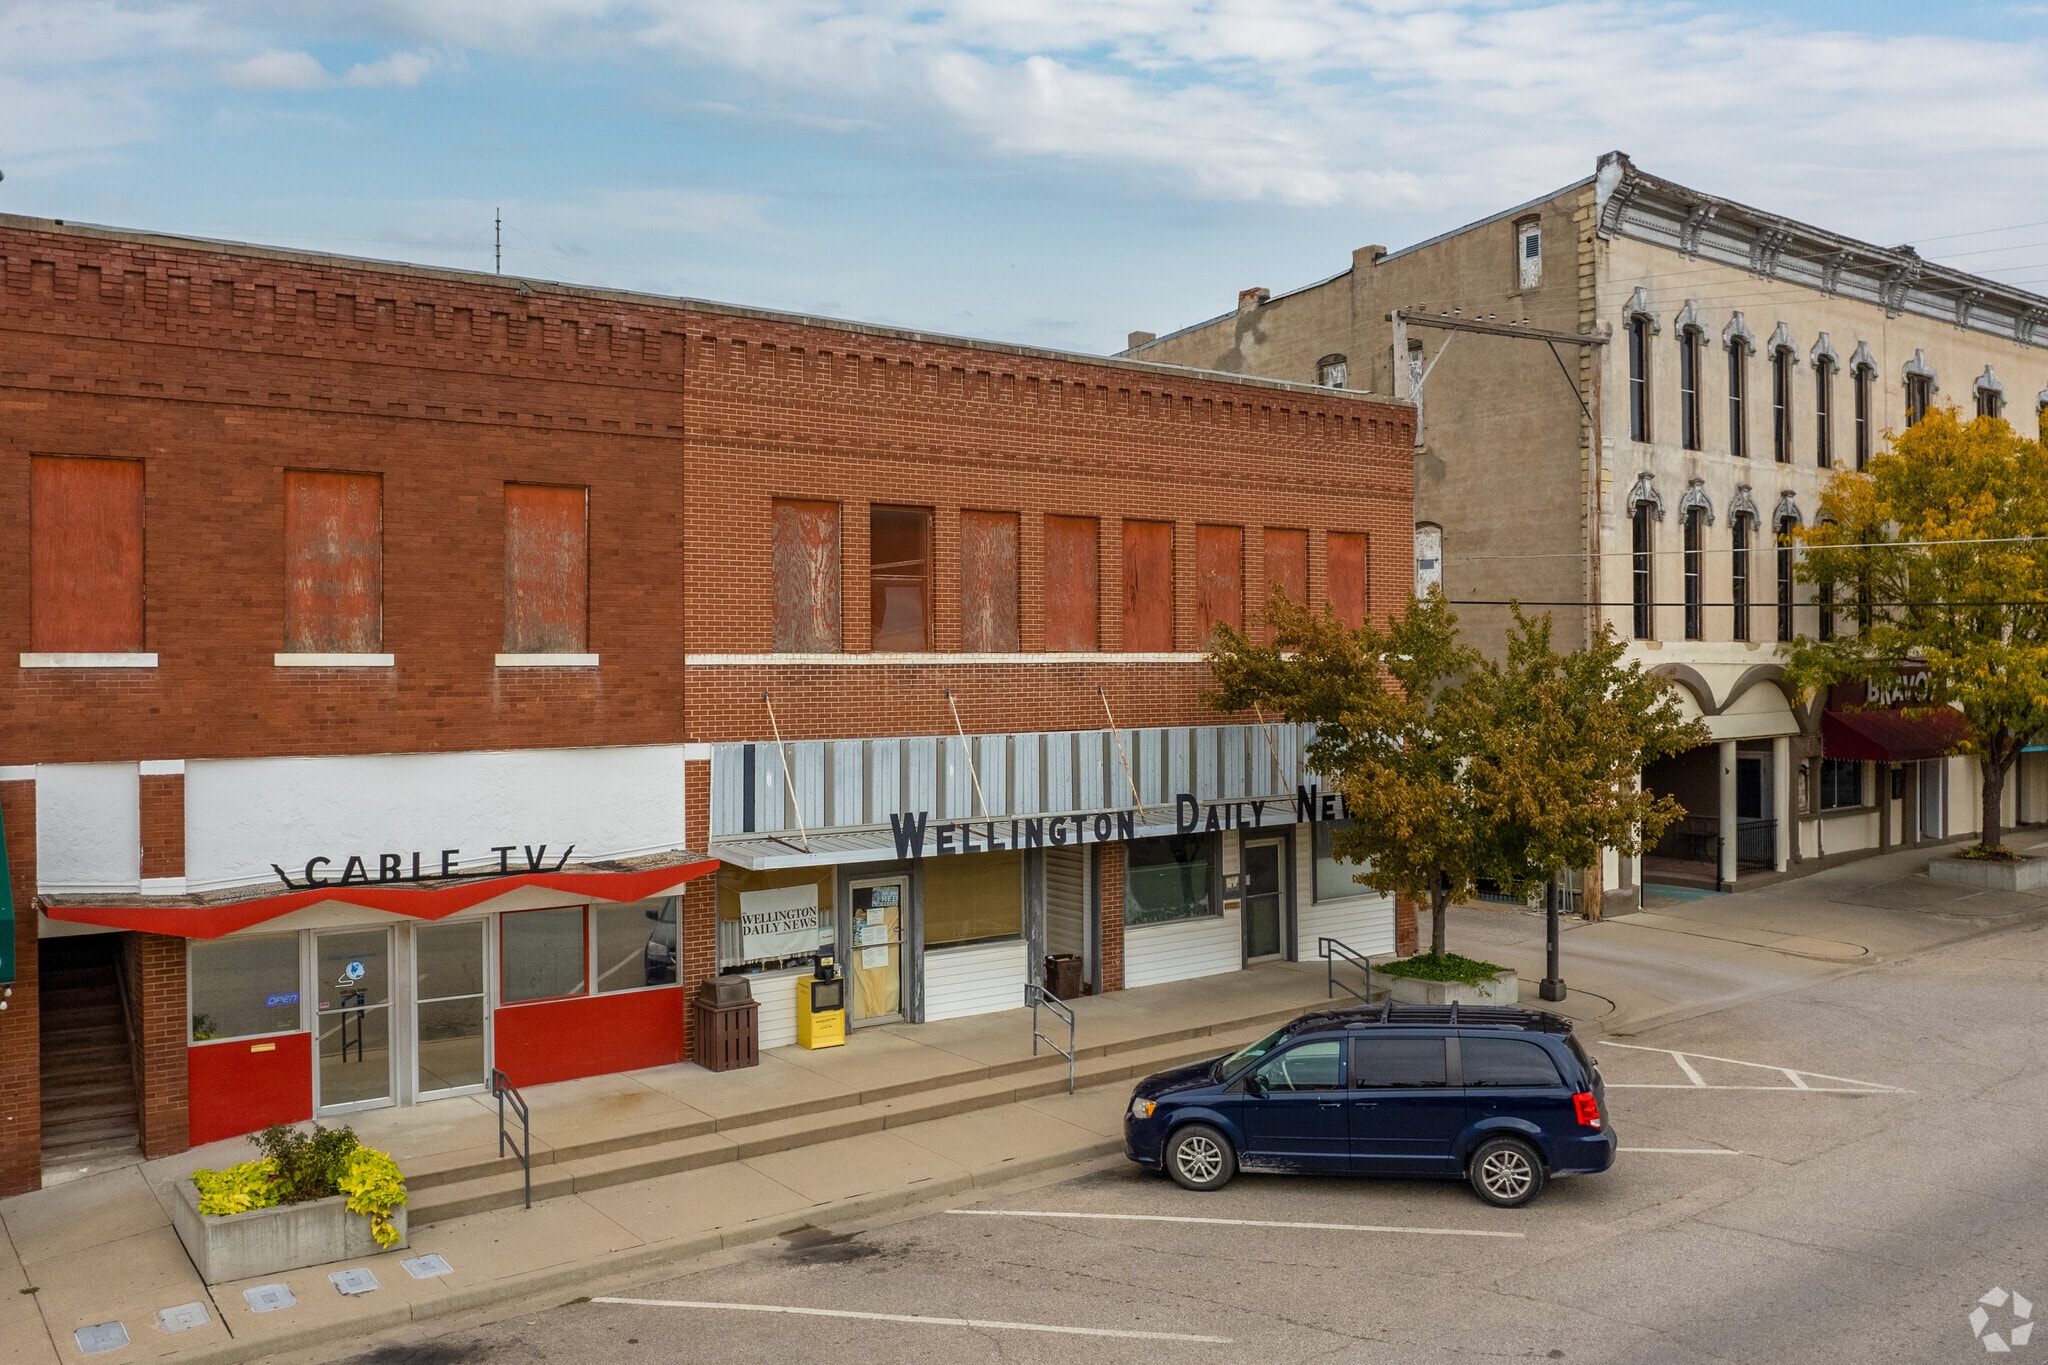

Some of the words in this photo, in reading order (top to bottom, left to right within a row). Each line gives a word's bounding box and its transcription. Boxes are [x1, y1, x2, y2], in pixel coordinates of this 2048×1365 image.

[889, 811, 1135, 859] WELLINGTON
[1176, 793, 1266, 835] DAILY
[304, 849, 460, 888] CABLE
[491, 844, 547, 874] TV
[742, 906, 818, 925] WELLINGTON
[743, 922, 781, 936] DAILY
[783, 916, 817, 931] NEWS
[268, 994, 298, 1005] OPEN
